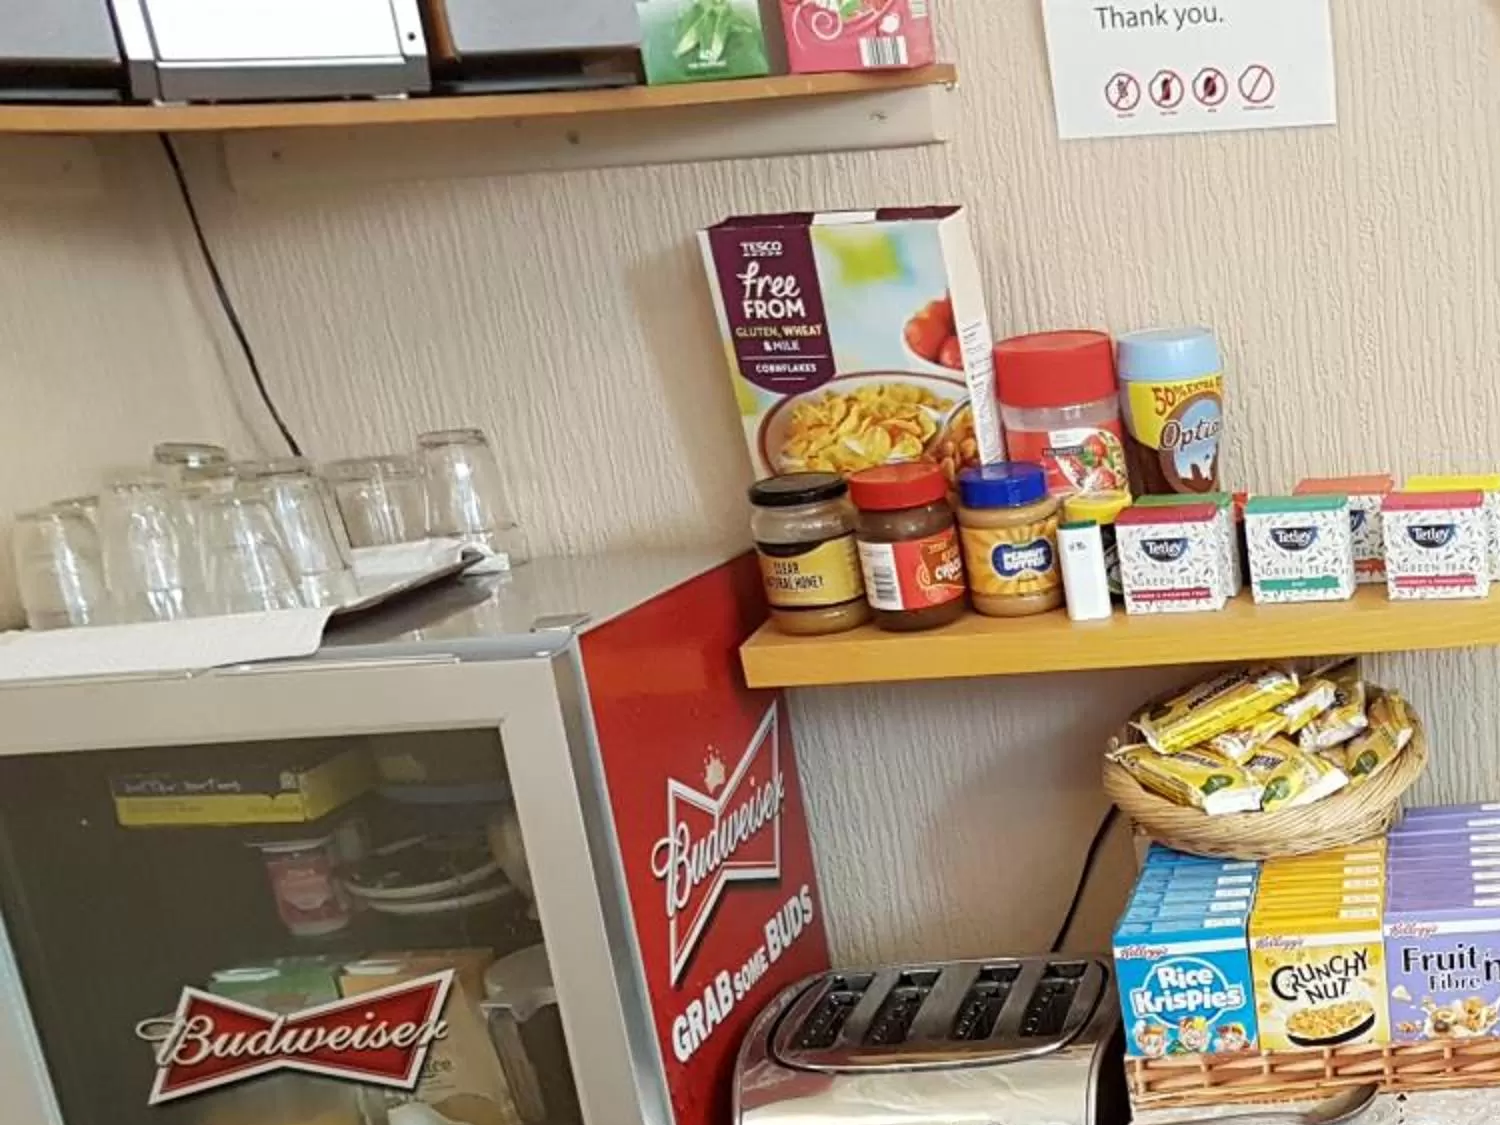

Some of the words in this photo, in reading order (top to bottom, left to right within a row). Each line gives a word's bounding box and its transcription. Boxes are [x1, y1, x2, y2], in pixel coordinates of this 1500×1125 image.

[1094, 4, 1168, 29] Thank
[1175, 5, 1224, 31] you.
[740, 241, 783, 253] TESCO
[736, 260, 800, 299] free
[743, 298, 806, 319] FROM
[736, 326, 782, 338] GLUTEN,
[782, 323, 822, 336] WHEAT
[755, 363, 817, 374] CORNFLAKES
[1145, 540, 1181, 557] Tetley
[1275, 529, 1311, 545] Tetley
[1412, 527, 1449, 544] Tetley
[652, 774, 784, 918] Budweiser
[1403, 944, 1477, 972] Fruit
[672, 970, 734, 1062] GRAB
[734, 947, 769, 1000] SOME
[765, 884, 813, 963] BUDS
[1157, 964, 1213, 990] Rice
[1271, 947, 1369, 1001] CRUNCHY
[1430, 973, 1480, 990] Fibre
[1132, 983, 1243, 1014] Krispies
[1306, 976, 1350, 1004] NUT
[136, 1011, 449, 1067] Budweiser
